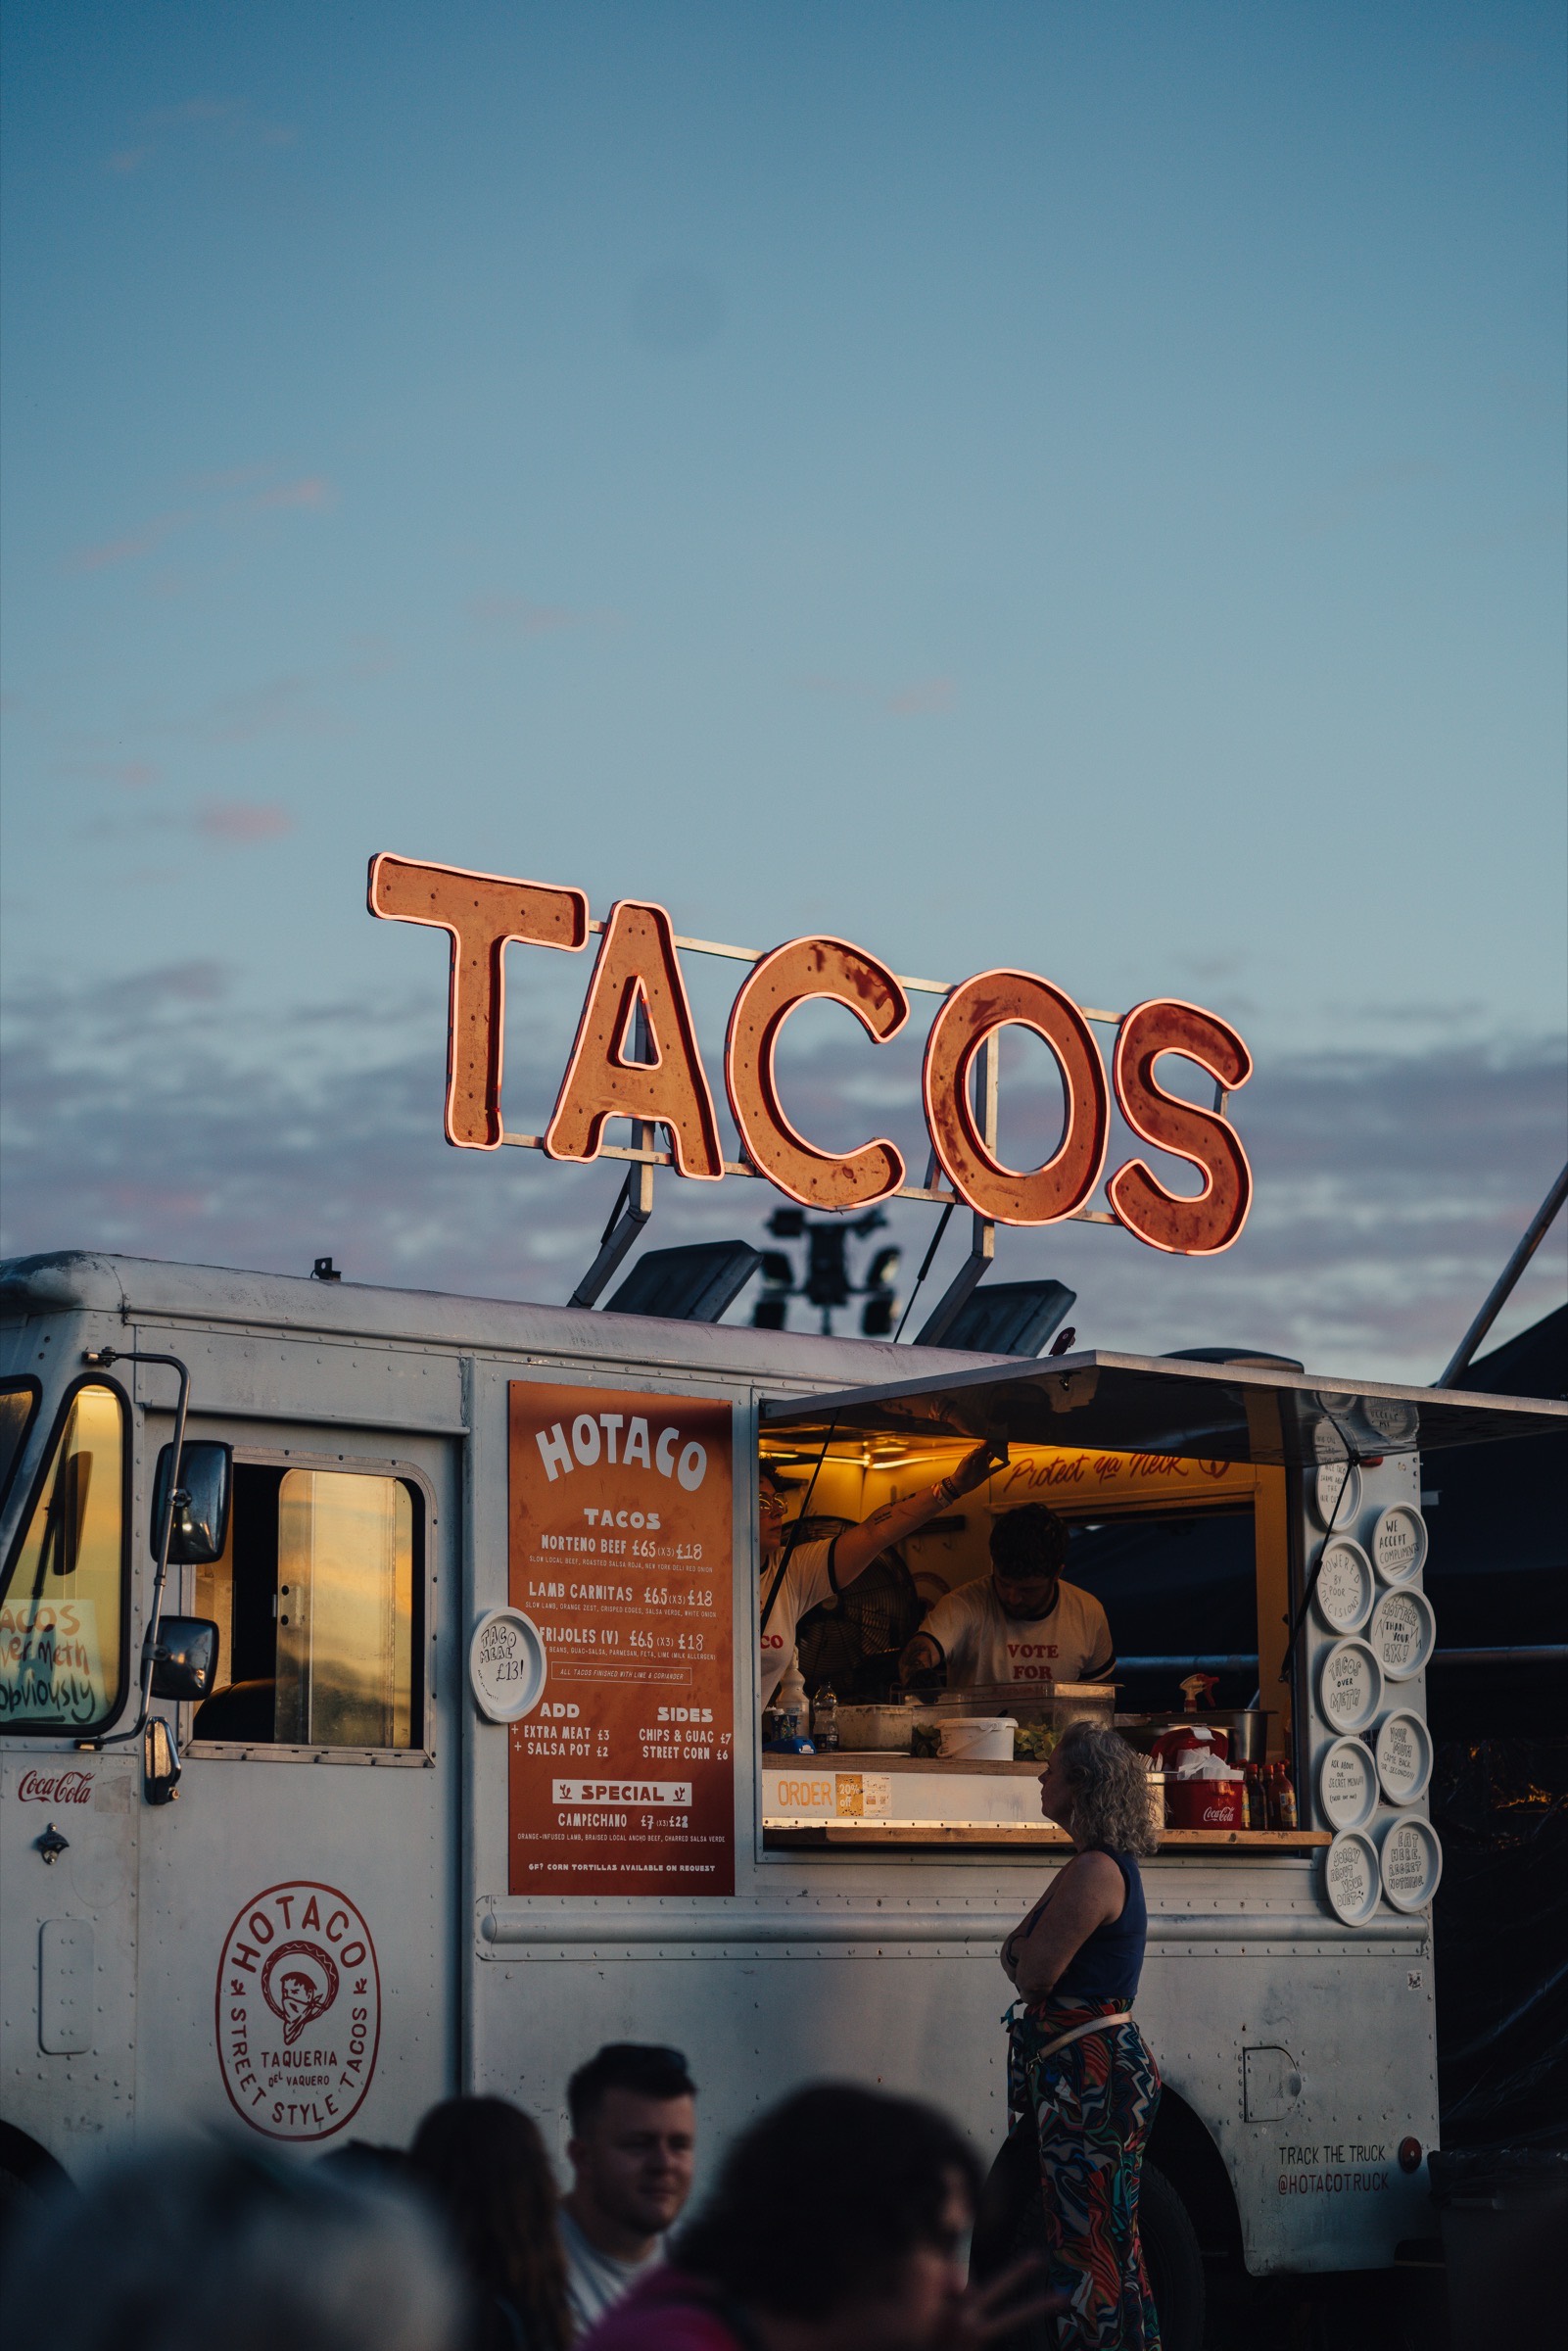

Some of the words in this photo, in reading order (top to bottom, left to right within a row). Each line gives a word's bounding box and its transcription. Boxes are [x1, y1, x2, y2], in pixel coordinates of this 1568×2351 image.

[366, 850, 1255, 1257] TACOS
[535, 1414, 707, 1491] HOTACO
[1004, 1454, 1090, 1493] Protect
[1093, 1456, 1122, 1486] ya
[584, 1508, 661, 1530] TACOS
[1386, 1519, 1398, 1533] WE
[542, 1535, 595, 1553] NORTENO
[600, 1539, 627, 1555] BEEF
[657, 1546, 675, 1558] (X3)
[676, 1543, 702, 1560] £18
[1379, 1534, 1406, 1549] ACCEPT
[1379, 1543, 1419, 1564] COMPLIMENTS
[1322, 1554, 1360, 1584] POWERED
[1334, 1574, 1342, 1585] BY
[529, 1581, 565, 1598] LAMB
[570, 1583, 634, 1602] CARNITAS
[669, 1595, 686, 1605] (X3)
[688, 1589, 713, 1607] £18
[1329, 1586, 1346, 1597] POOR
[542, 1602, 558, 1610] LAMB,
[624, 1607, 643, 1615] EDGES,
[1321, 1590, 1359, 1617] DECISIONS
[0, 1605, 80, 1636] ACOS
[1382, 1603, 1417, 1626] HOTTER
[1386, 1621, 1404, 1631] THAN
[481, 1626, 517, 1648] TACO
[539, 1626, 596, 1645] FRIJOLES
[601, 1629, 619, 1645] (V)
[656, 1637, 674, 1648] (X3)
[678, 1633, 704, 1651] £18
[1393, 1632, 1410, 1644] YOUR
[480, 1646, 513, 1663] MEAL
[609, 1649, 639, 1657] PARMESAN,
[1008, 1644, 1059, 1658] VOTE
[1383, 1643, 1409, 1663] EX!
[496, 1659, 524, 1682] £13!
[1013, 1665, 1053, 1679] FOR
[1328, 1655, 1361, 1681] TACOS
[1337, 1678, 1354, 1687] OVER
[1330, 1689, 1360, 1712] METH
[540, 1703, 580, 1718] ADD
[657, 1706, 713, 1723] SIDES
[524, 1725, 557, 1740] EXTRA
[561, 1726, 592, 1740] MEAT
[597, 1729, 610, 1741] £3
[639, 1728, 669, 1742] CHIPS
[674, 1730, 683, 1742] &
[686, 1730, 714, 1744] GUAC
[720, 1733, 732, 1745] £7
[1390, 1726, 1407, 1744] YOUR
[527, 1743, 565, 1756] SALSA
[569, 1744, 591, 1756] POT
[596, 1746, 609, 1757] £2
[642, 1746, 680, 1759] STREET
[684, 1747, 710, 1760] CORN
[716, 1750, 729, 1760] £6
[1341, 1760, 1354, 1770] ABOUT
[1383, 1751, 1397, 1764] CAME
[1399, 1757, 1411, 1768] BACK
[839, 1783, 860, 1796] 20%
[1328, 1777, 1346, 1789] SECRET
[581, 1785, 665, 1801] SPECIAL
[778, 1780, 832, 1806] ORDER
[839, 1796, 852, 1807] off
[557, 1812, 628, 1828] CAMPECHANO
[641, 1814, 654, 1830] £7
[1398, 1831, 1419, 1847] EAT
[1333, 1847, 1360, 1867] SORRY
[1391, 1848, 1421, 1862] HERE.
[1330, 1864, 1354, 1883] ABOUT
[1389, 1861, 1421, 1877] REGRET
[1342, 1875, 1363, 1894] YOUR
[1388, 1875, 1424, 1890] NOTHING.
[1337, 1891, 1357, 1907] DIET
[230, 1895, 366, 1974] HOTACO
[230, 2007, 266, 2106] STREET
[271, 2093, 339, 2125] STYLE
[339, 2007, 367, 2088] TACOS
[261, 2050, 337, 2068] TAQUERIA
[268, 2071, 283, 2087] DEL
[286, 2075, 330, 2087] VAQUERO
[1279, 2146, 1319, 2165] TRACK
[1323, 2144, 1346, 2163] THE
[1349, 2144, 1386, 2163] TRUCK
[1278, 2172, 1389, 2195] @HOTACOTRUCK
